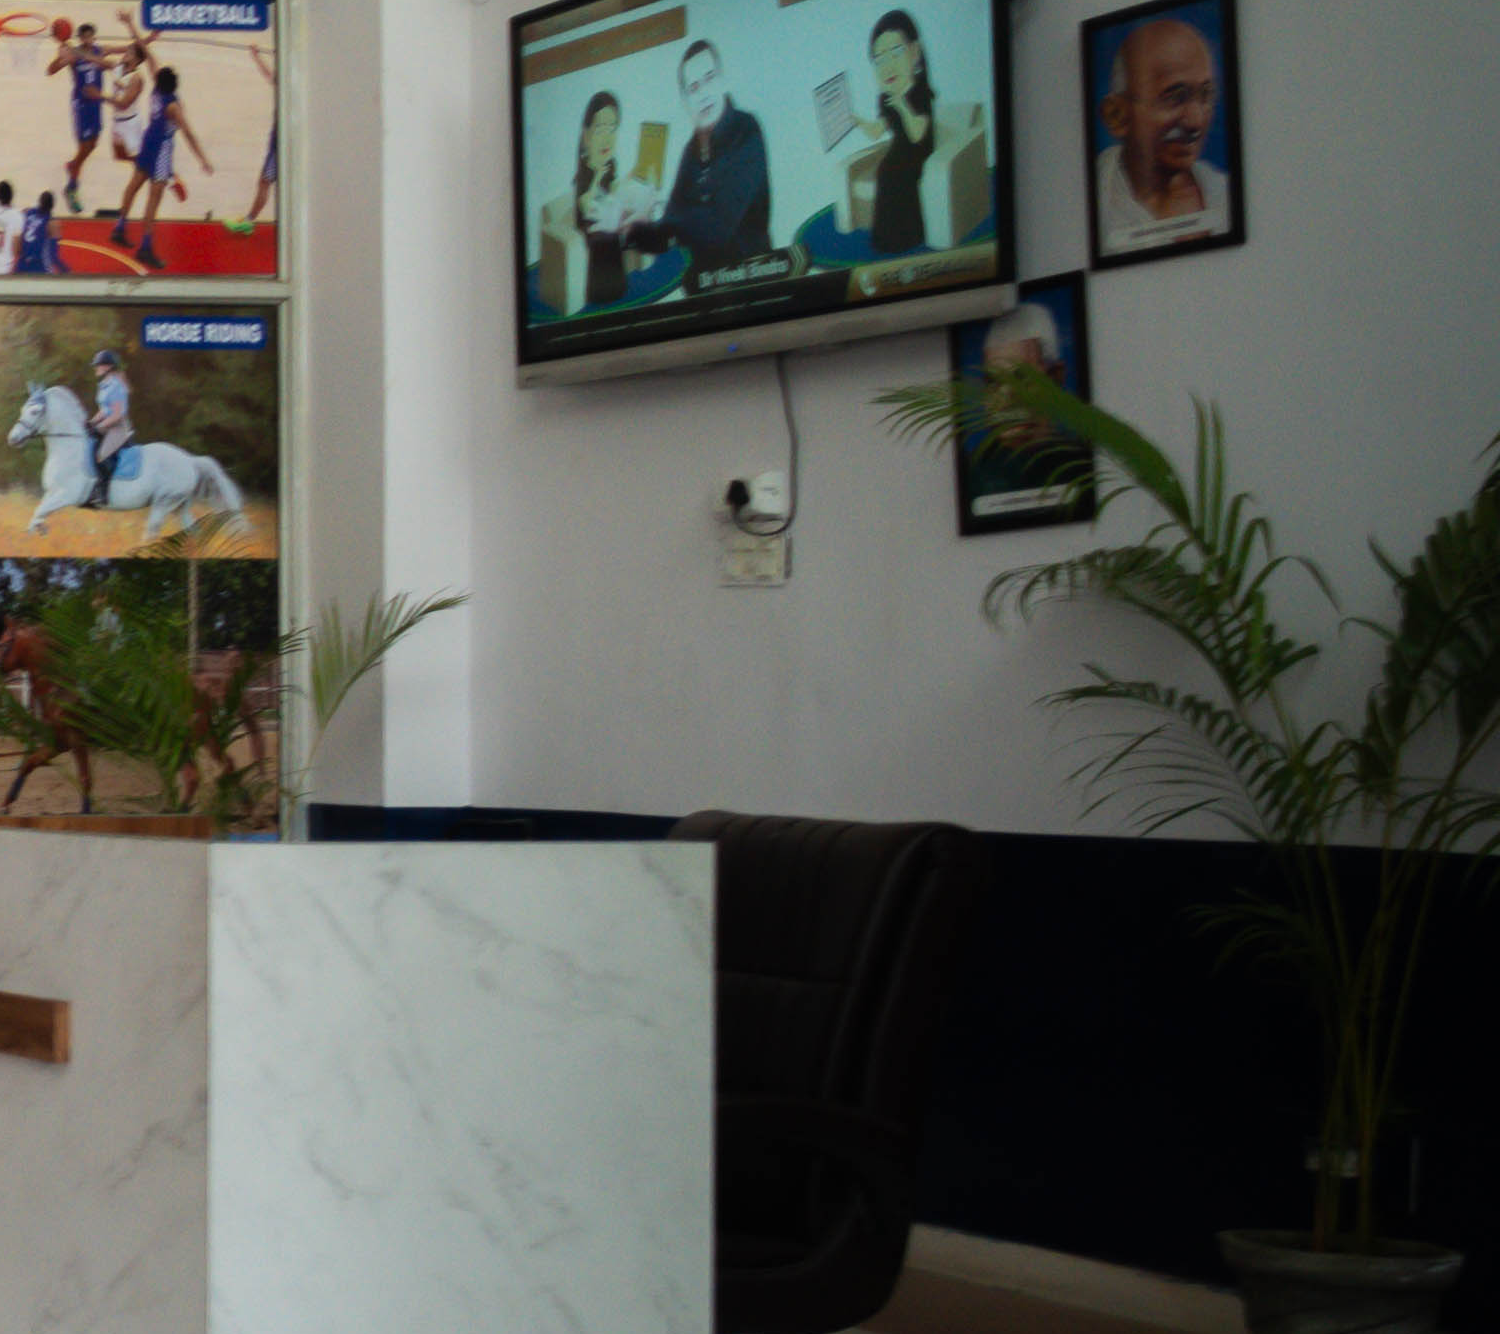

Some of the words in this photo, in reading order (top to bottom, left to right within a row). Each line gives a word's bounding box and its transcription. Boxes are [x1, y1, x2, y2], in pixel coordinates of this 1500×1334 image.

[150, 3, 260, 25] BASKETBALL
[145, 322, 201, 344] HORSE
[204, 322, 262, 345] RIDING
